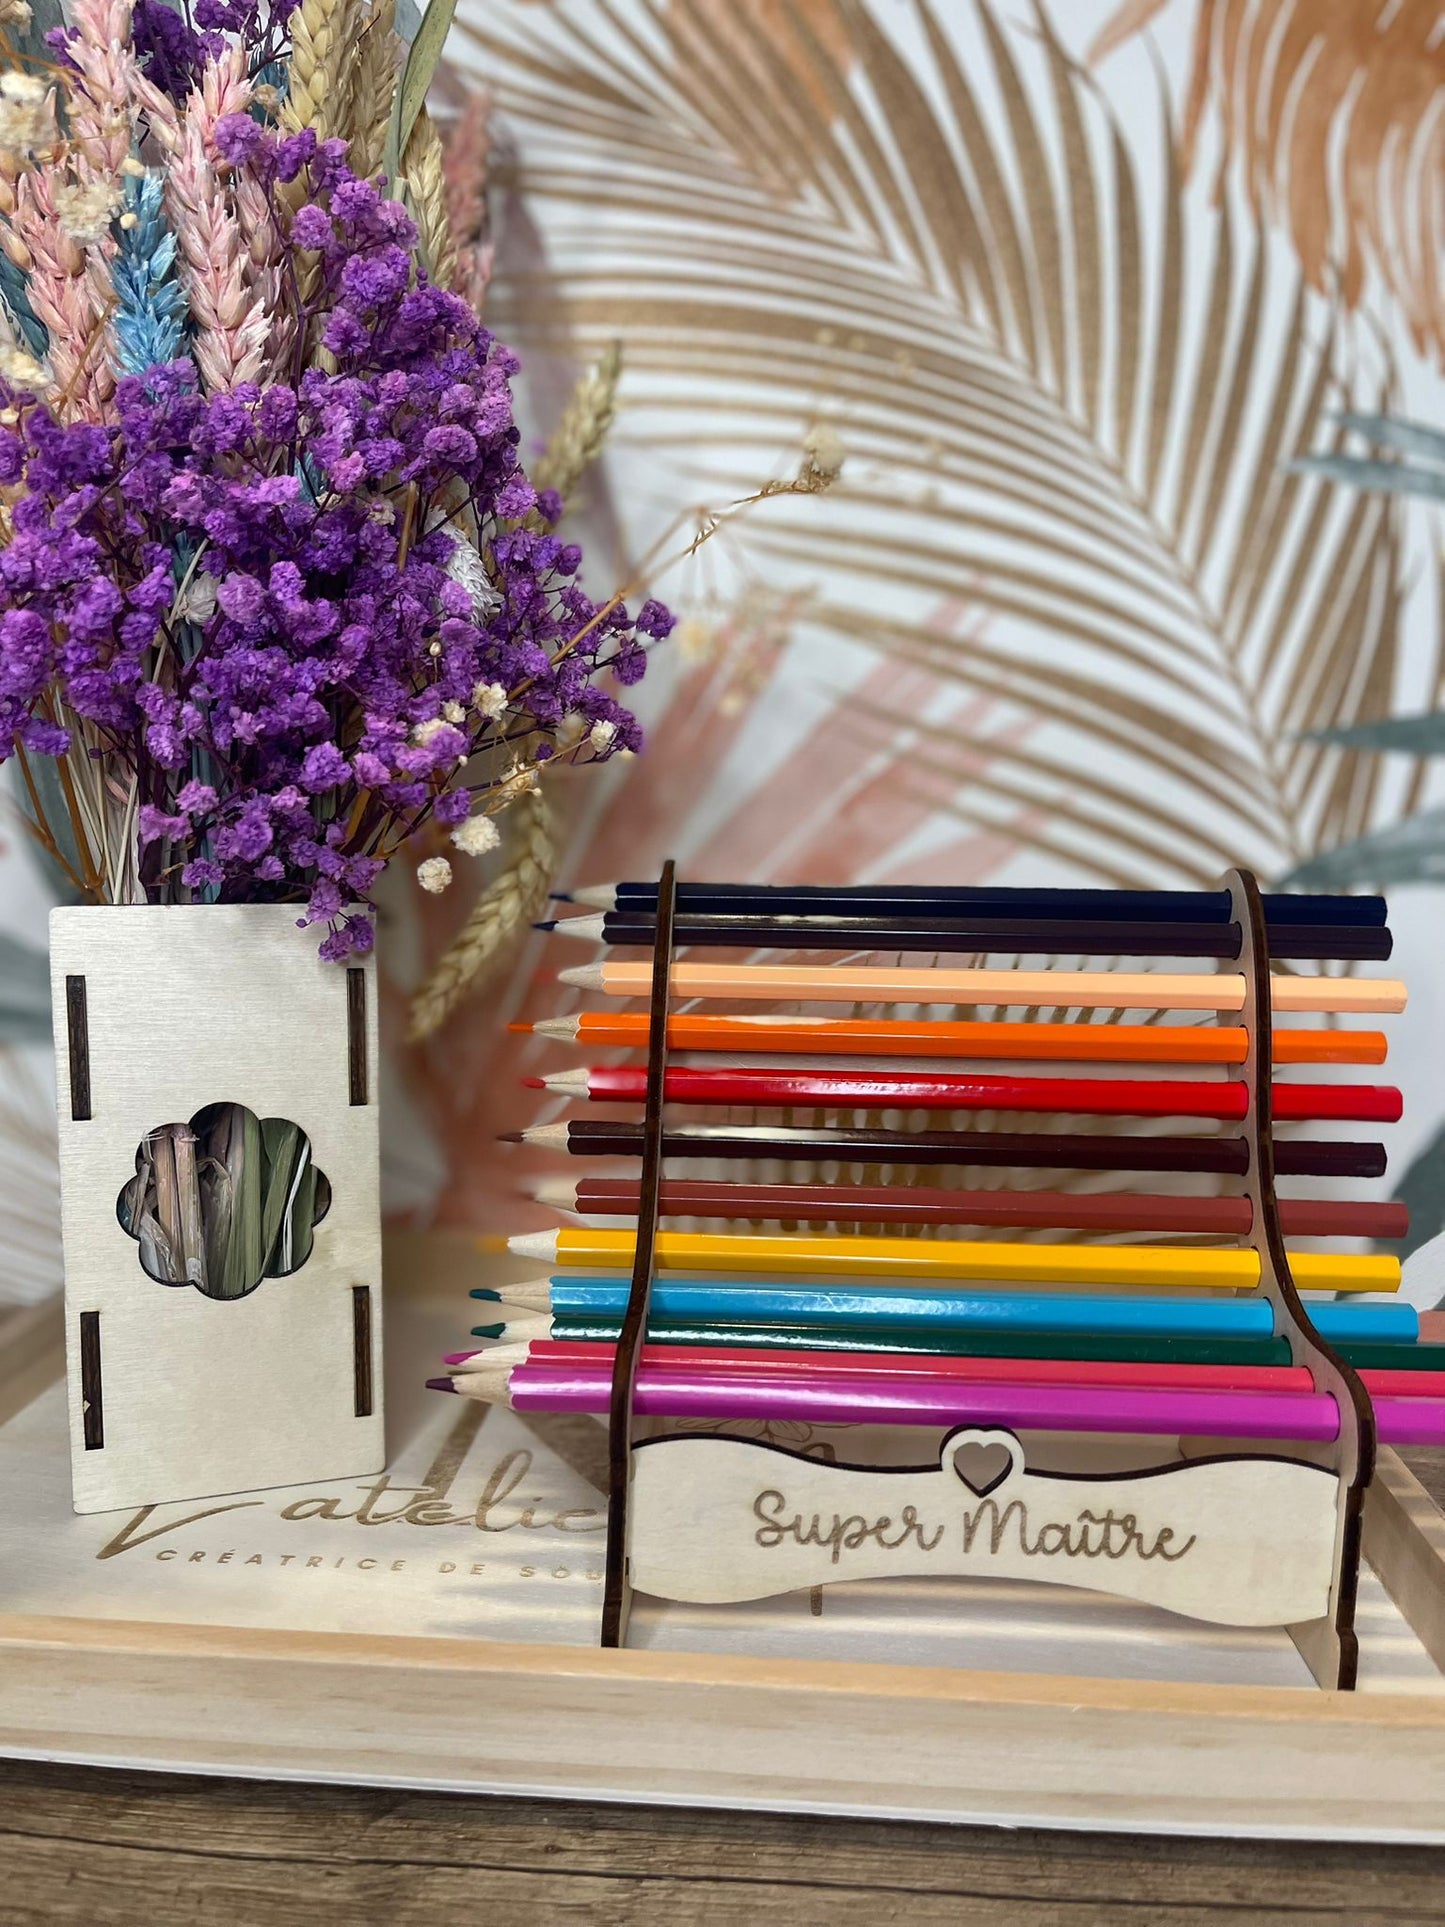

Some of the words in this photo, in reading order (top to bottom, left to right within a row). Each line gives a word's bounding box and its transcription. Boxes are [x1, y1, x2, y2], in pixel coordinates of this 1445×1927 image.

[753, 1489, 945, 1564] Super
[963, 1499, 1197, 1562] Maître
[156, 1549, 406, 1572] CRÉATRICE
[438, 1562, 486, 1576] DE
[518, 1565, 605, 1581] SOU
